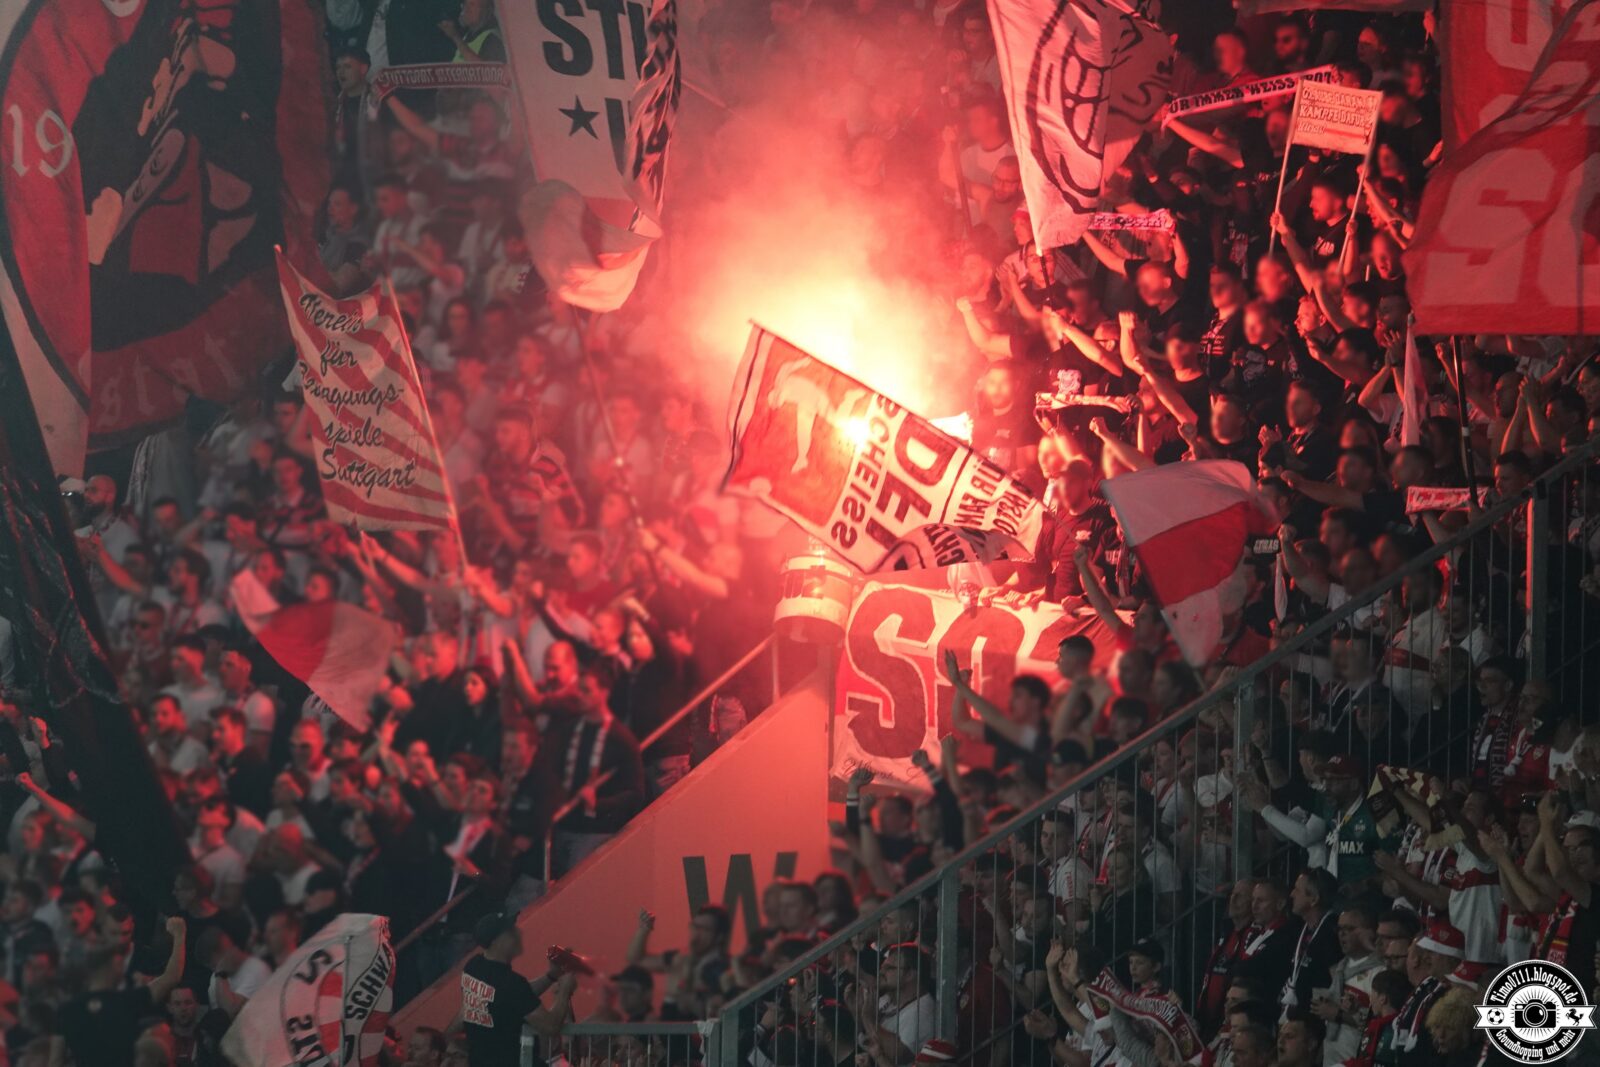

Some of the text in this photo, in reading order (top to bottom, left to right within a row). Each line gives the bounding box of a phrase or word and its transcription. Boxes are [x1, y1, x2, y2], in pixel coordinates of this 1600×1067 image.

[1194, 85, 1245, 108] IMMER
[1246, 76, 1297, 96] WEISS
[7, 104, 73, 178] 19
[320, 340, 358, 376] für
[324, 417, 383, 452] spiele
